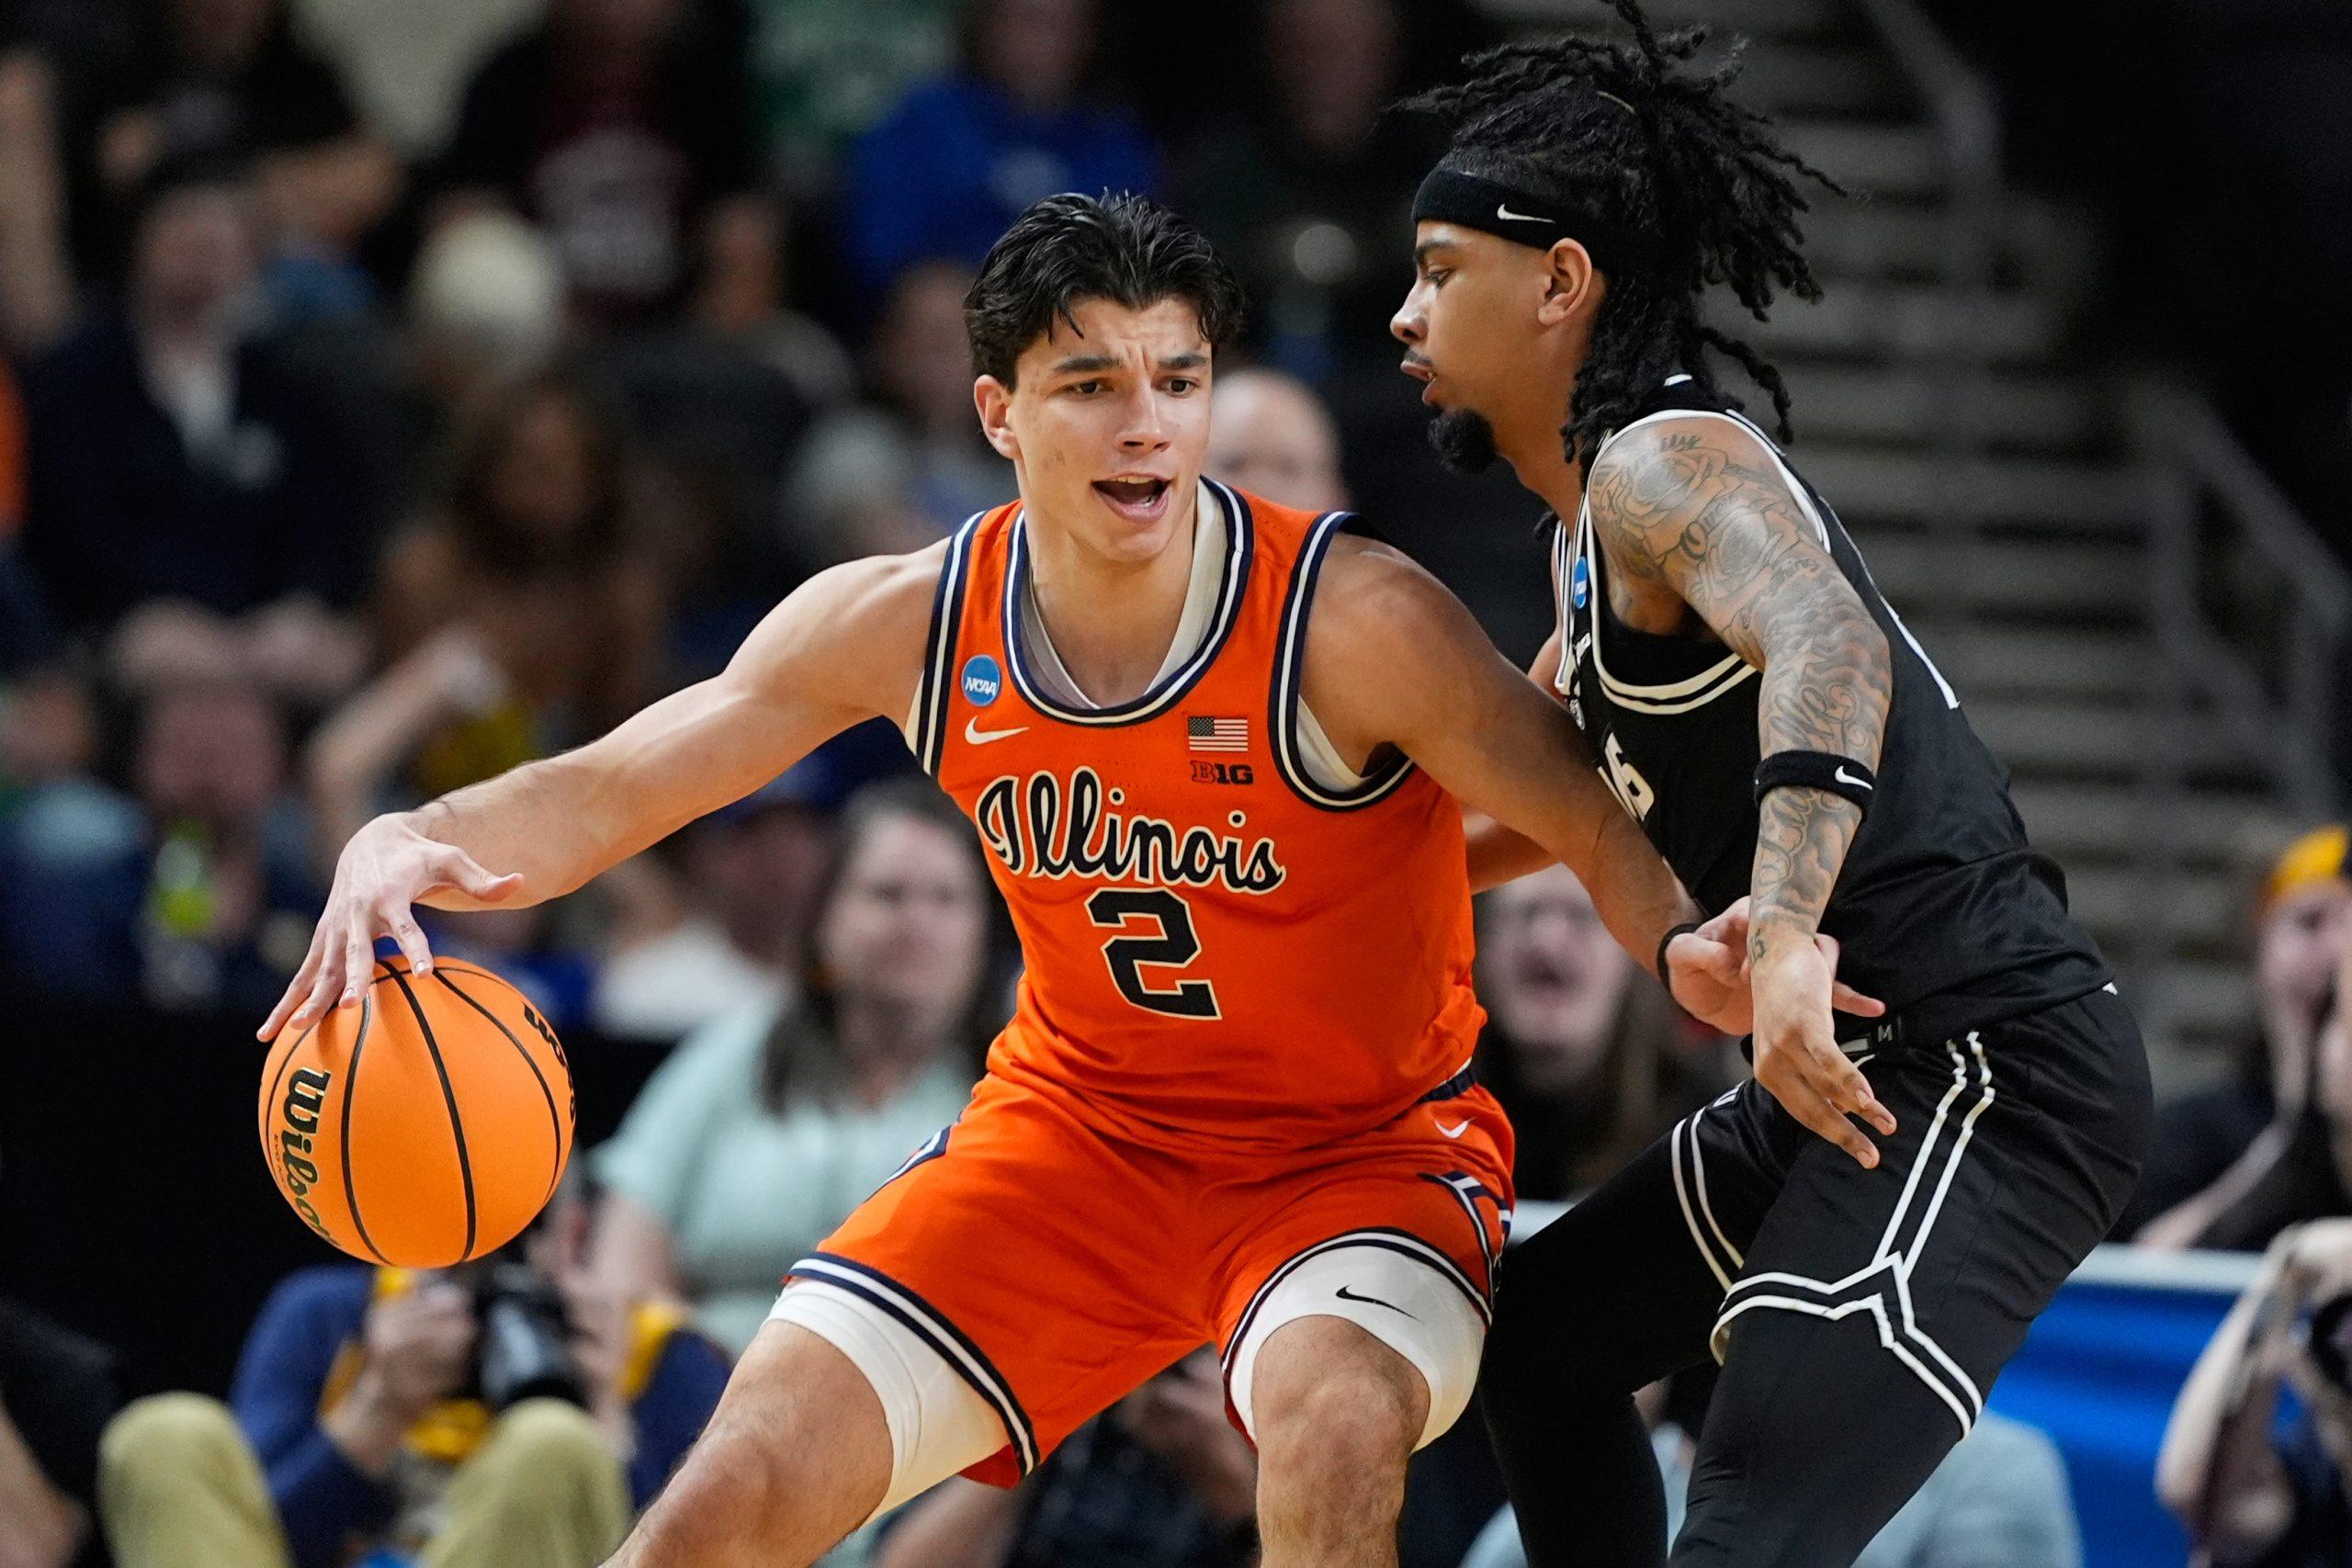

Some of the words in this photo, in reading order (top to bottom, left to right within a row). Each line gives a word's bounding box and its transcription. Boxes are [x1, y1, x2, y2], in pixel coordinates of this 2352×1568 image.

[965, 676, 997, 697] NCAA
[975, 765, 1287, 896] Illinois
[1083, 886, 1223, 1021] 2
